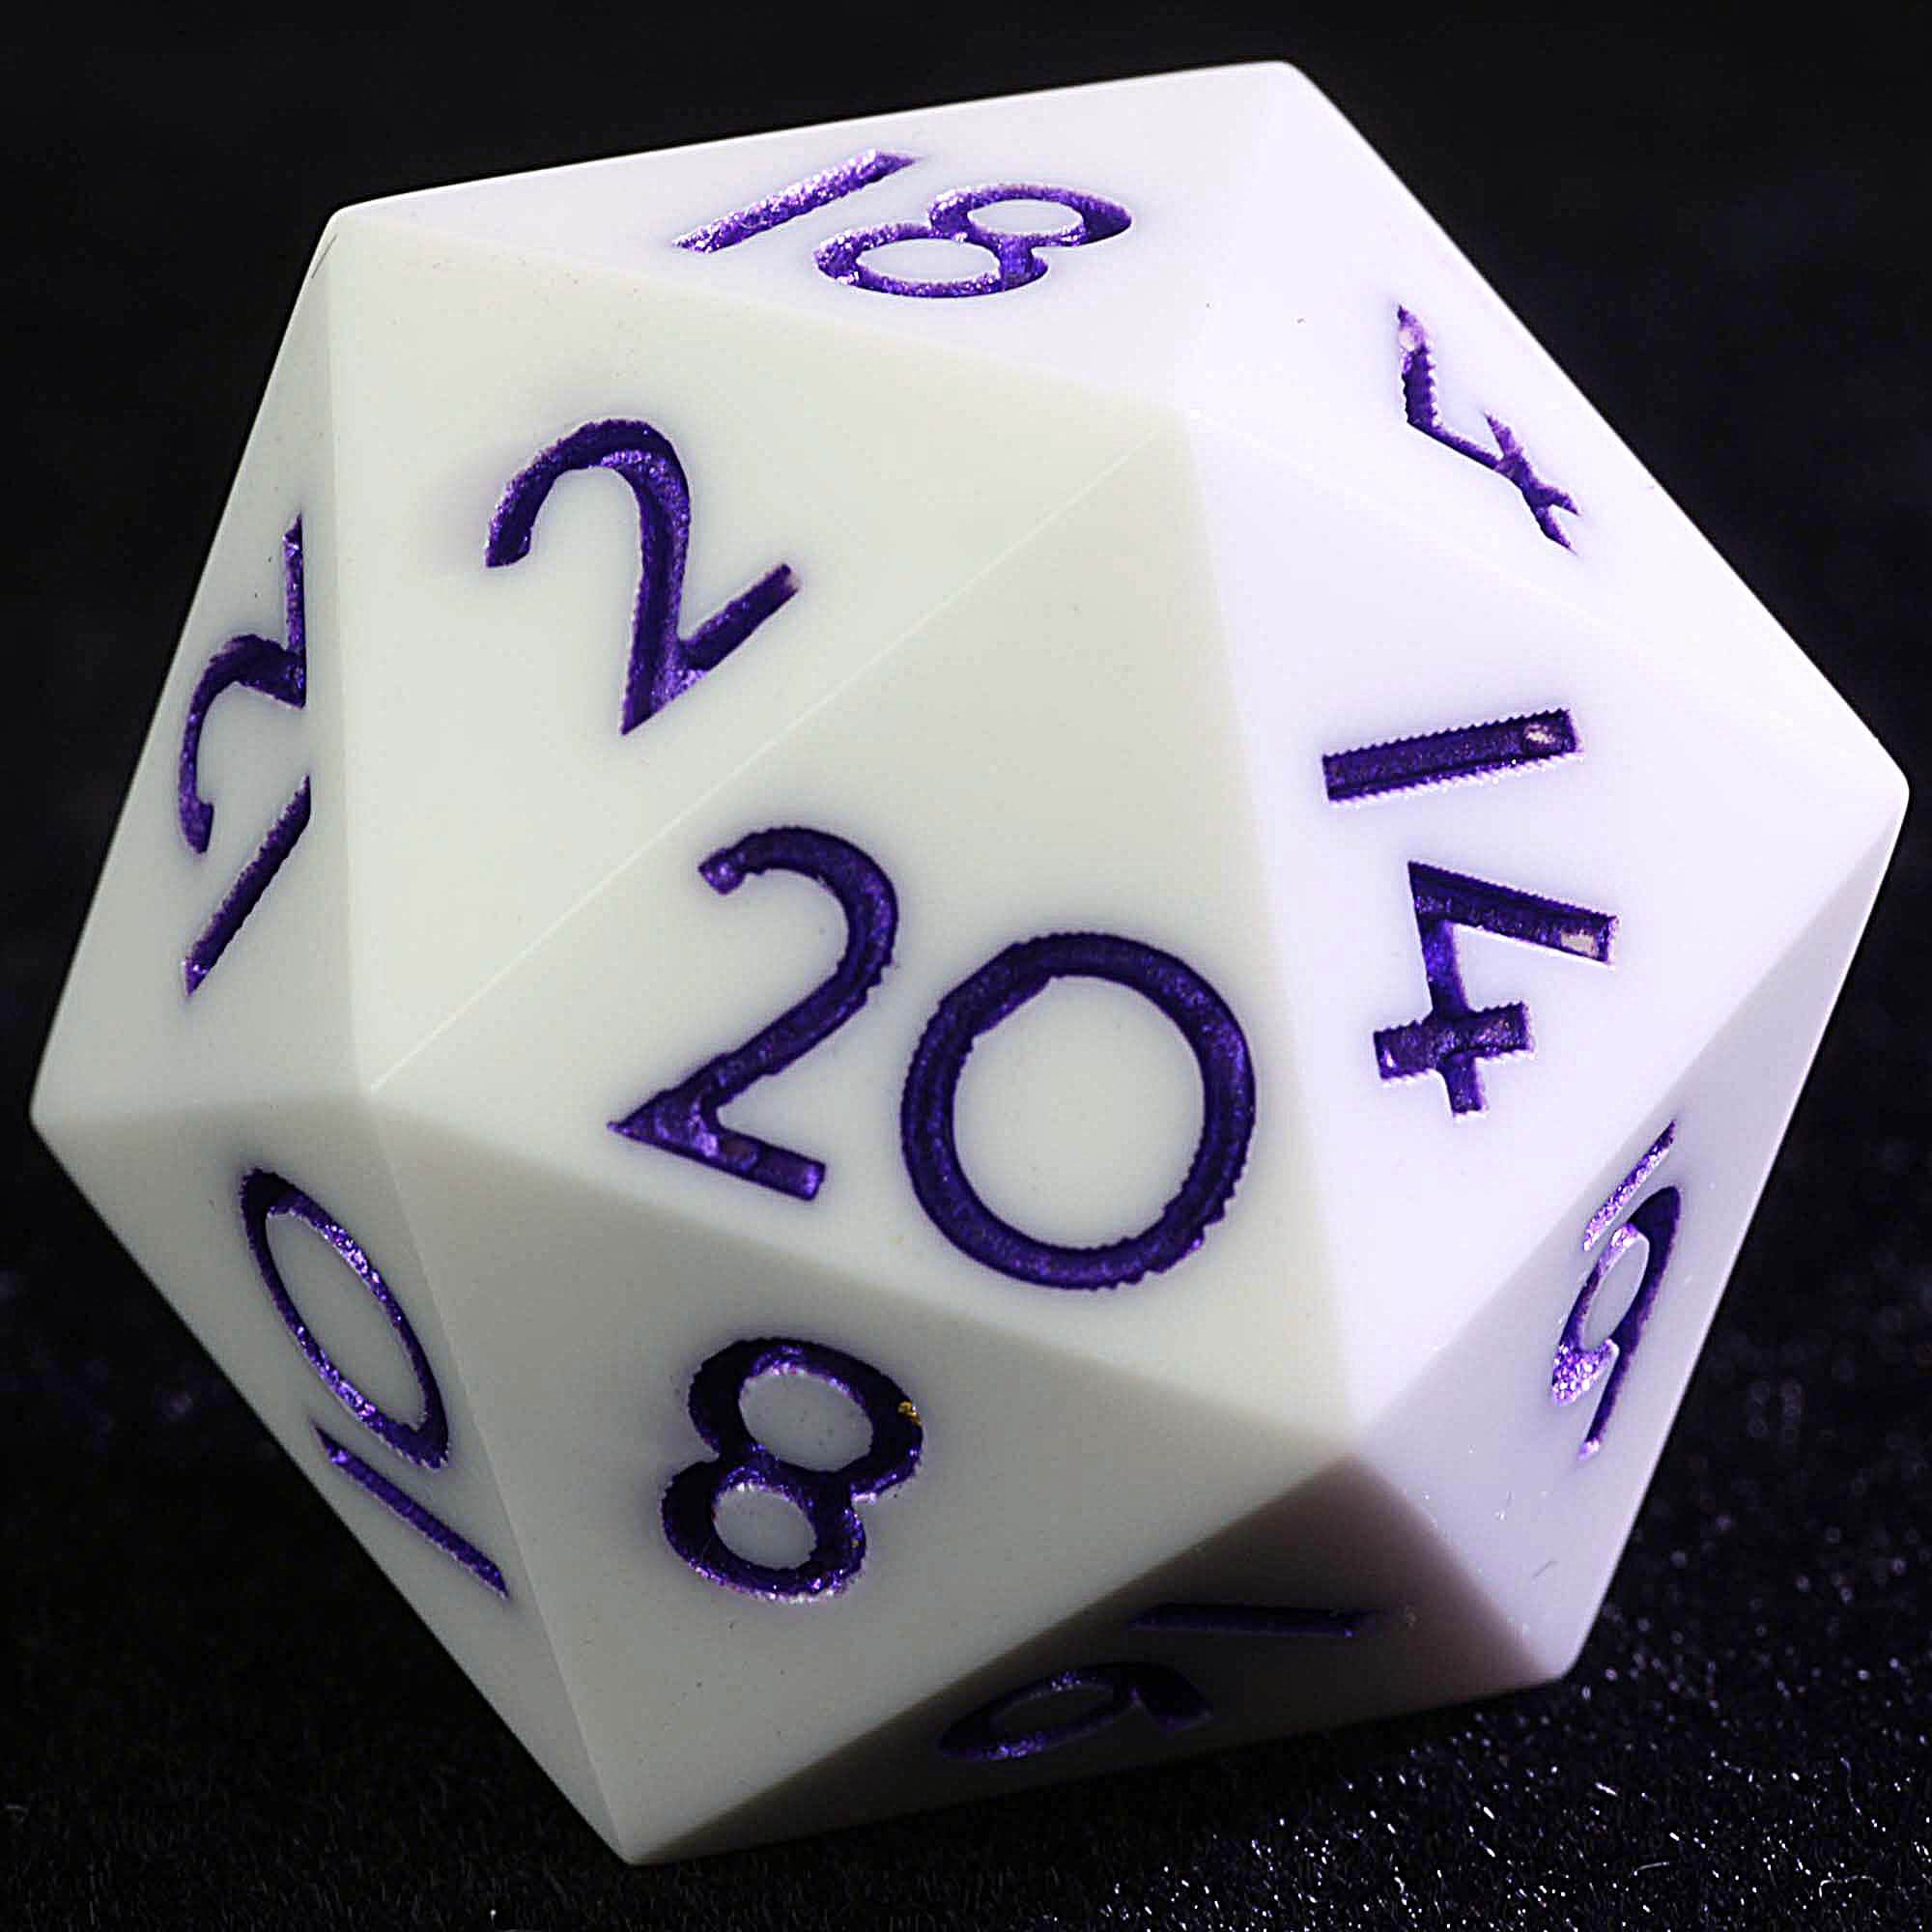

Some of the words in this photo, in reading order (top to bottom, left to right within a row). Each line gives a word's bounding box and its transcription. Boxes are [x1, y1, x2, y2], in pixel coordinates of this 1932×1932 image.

[671, 149, 1133, 299] 18
[486, 415, 801, 736] 2
[1396, 304, 1580, 554] 4
[177, 513, 312, 997] 12
[1322, 706, 1619, 1121] 14
[610, 825, 1258, 1293] 20
[240, 1168, 508, 1598] 10
[661, 1337, 923, 1604] 8
